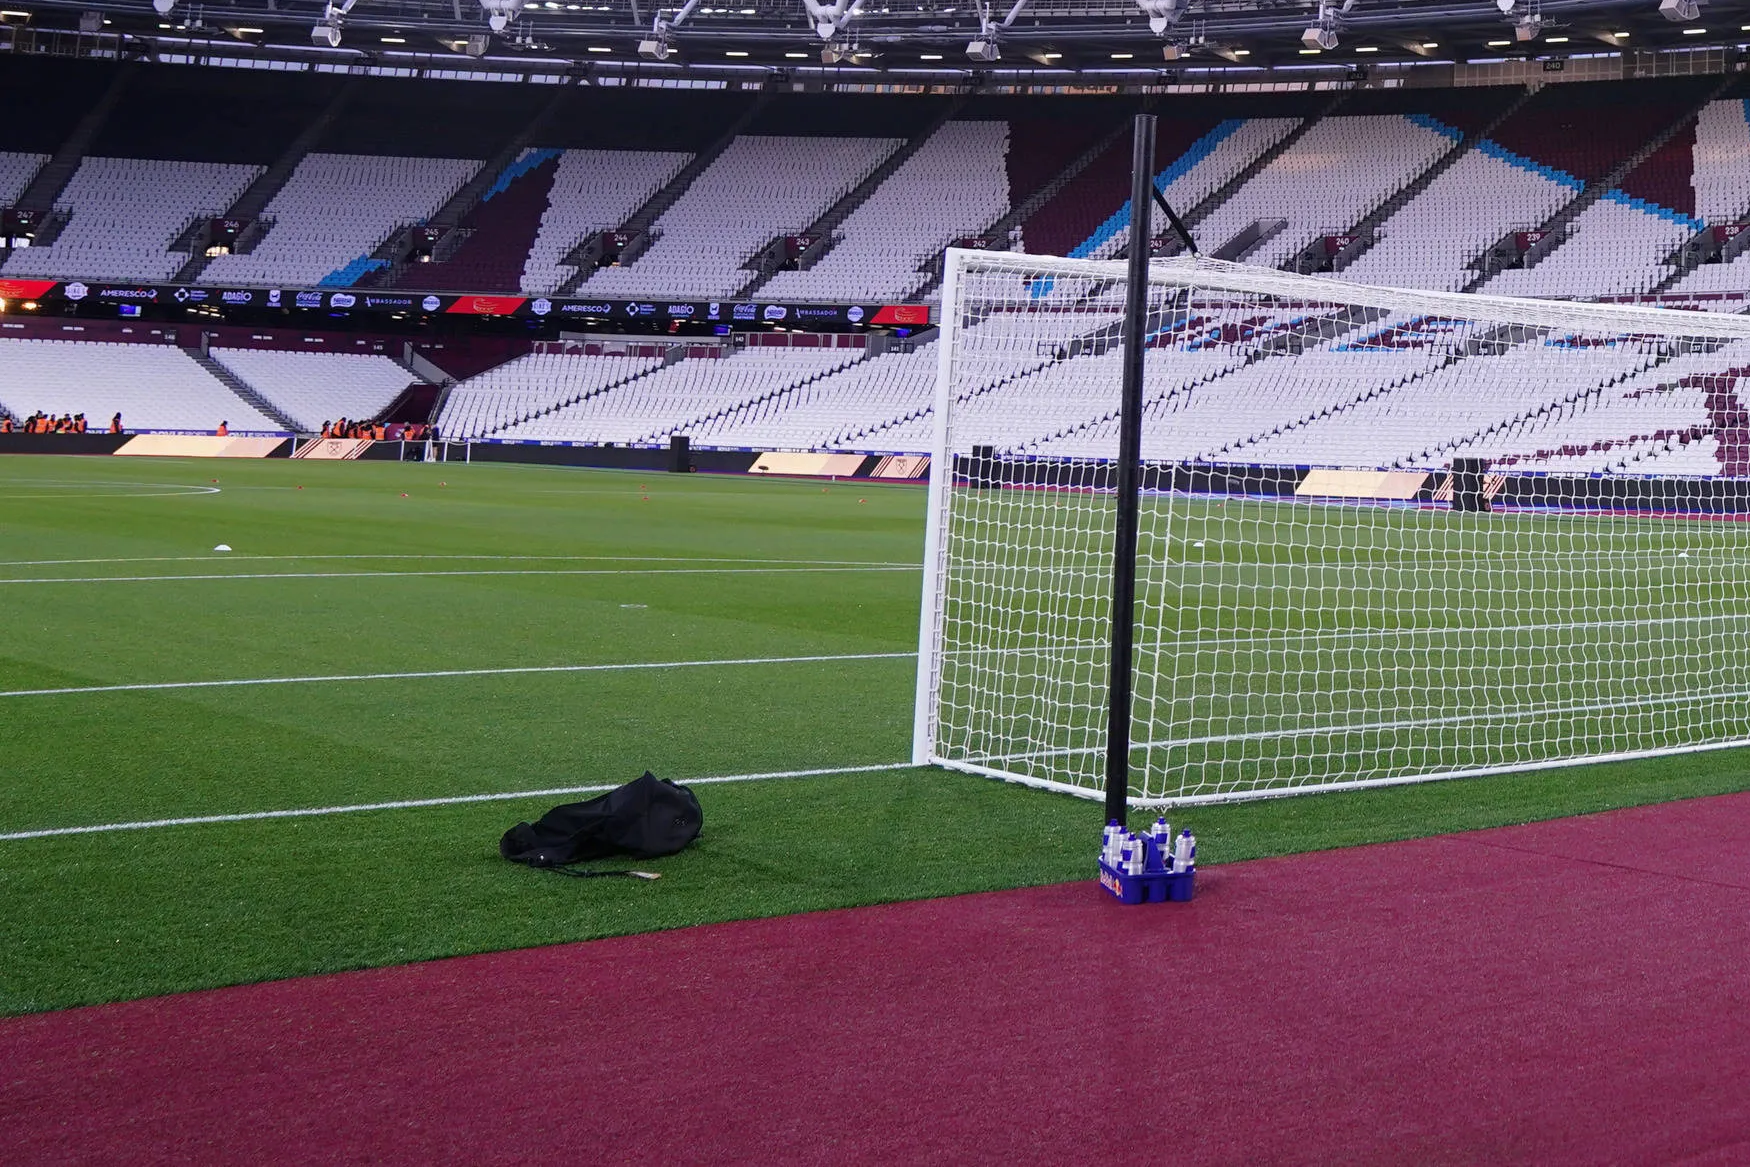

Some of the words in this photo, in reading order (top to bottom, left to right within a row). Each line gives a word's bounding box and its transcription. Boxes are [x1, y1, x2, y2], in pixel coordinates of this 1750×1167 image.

[1546, 61, 1561, 69] 240
[16, 210, 34, 219] 247
[224, 220, 240, 228] 246
[1725, 225, 1740, 235] 238
[613, 234, 628, 242] 244
[796, 237, 810, 246] 243
[1336, 237, 1350, 246] 240
[1526, 233, 1541, 242] 239
[972, 240, 987, 248] 242
[101, 289, 148, 298] AMERESCO
[561, 305, 603, 313] AMERESCO
